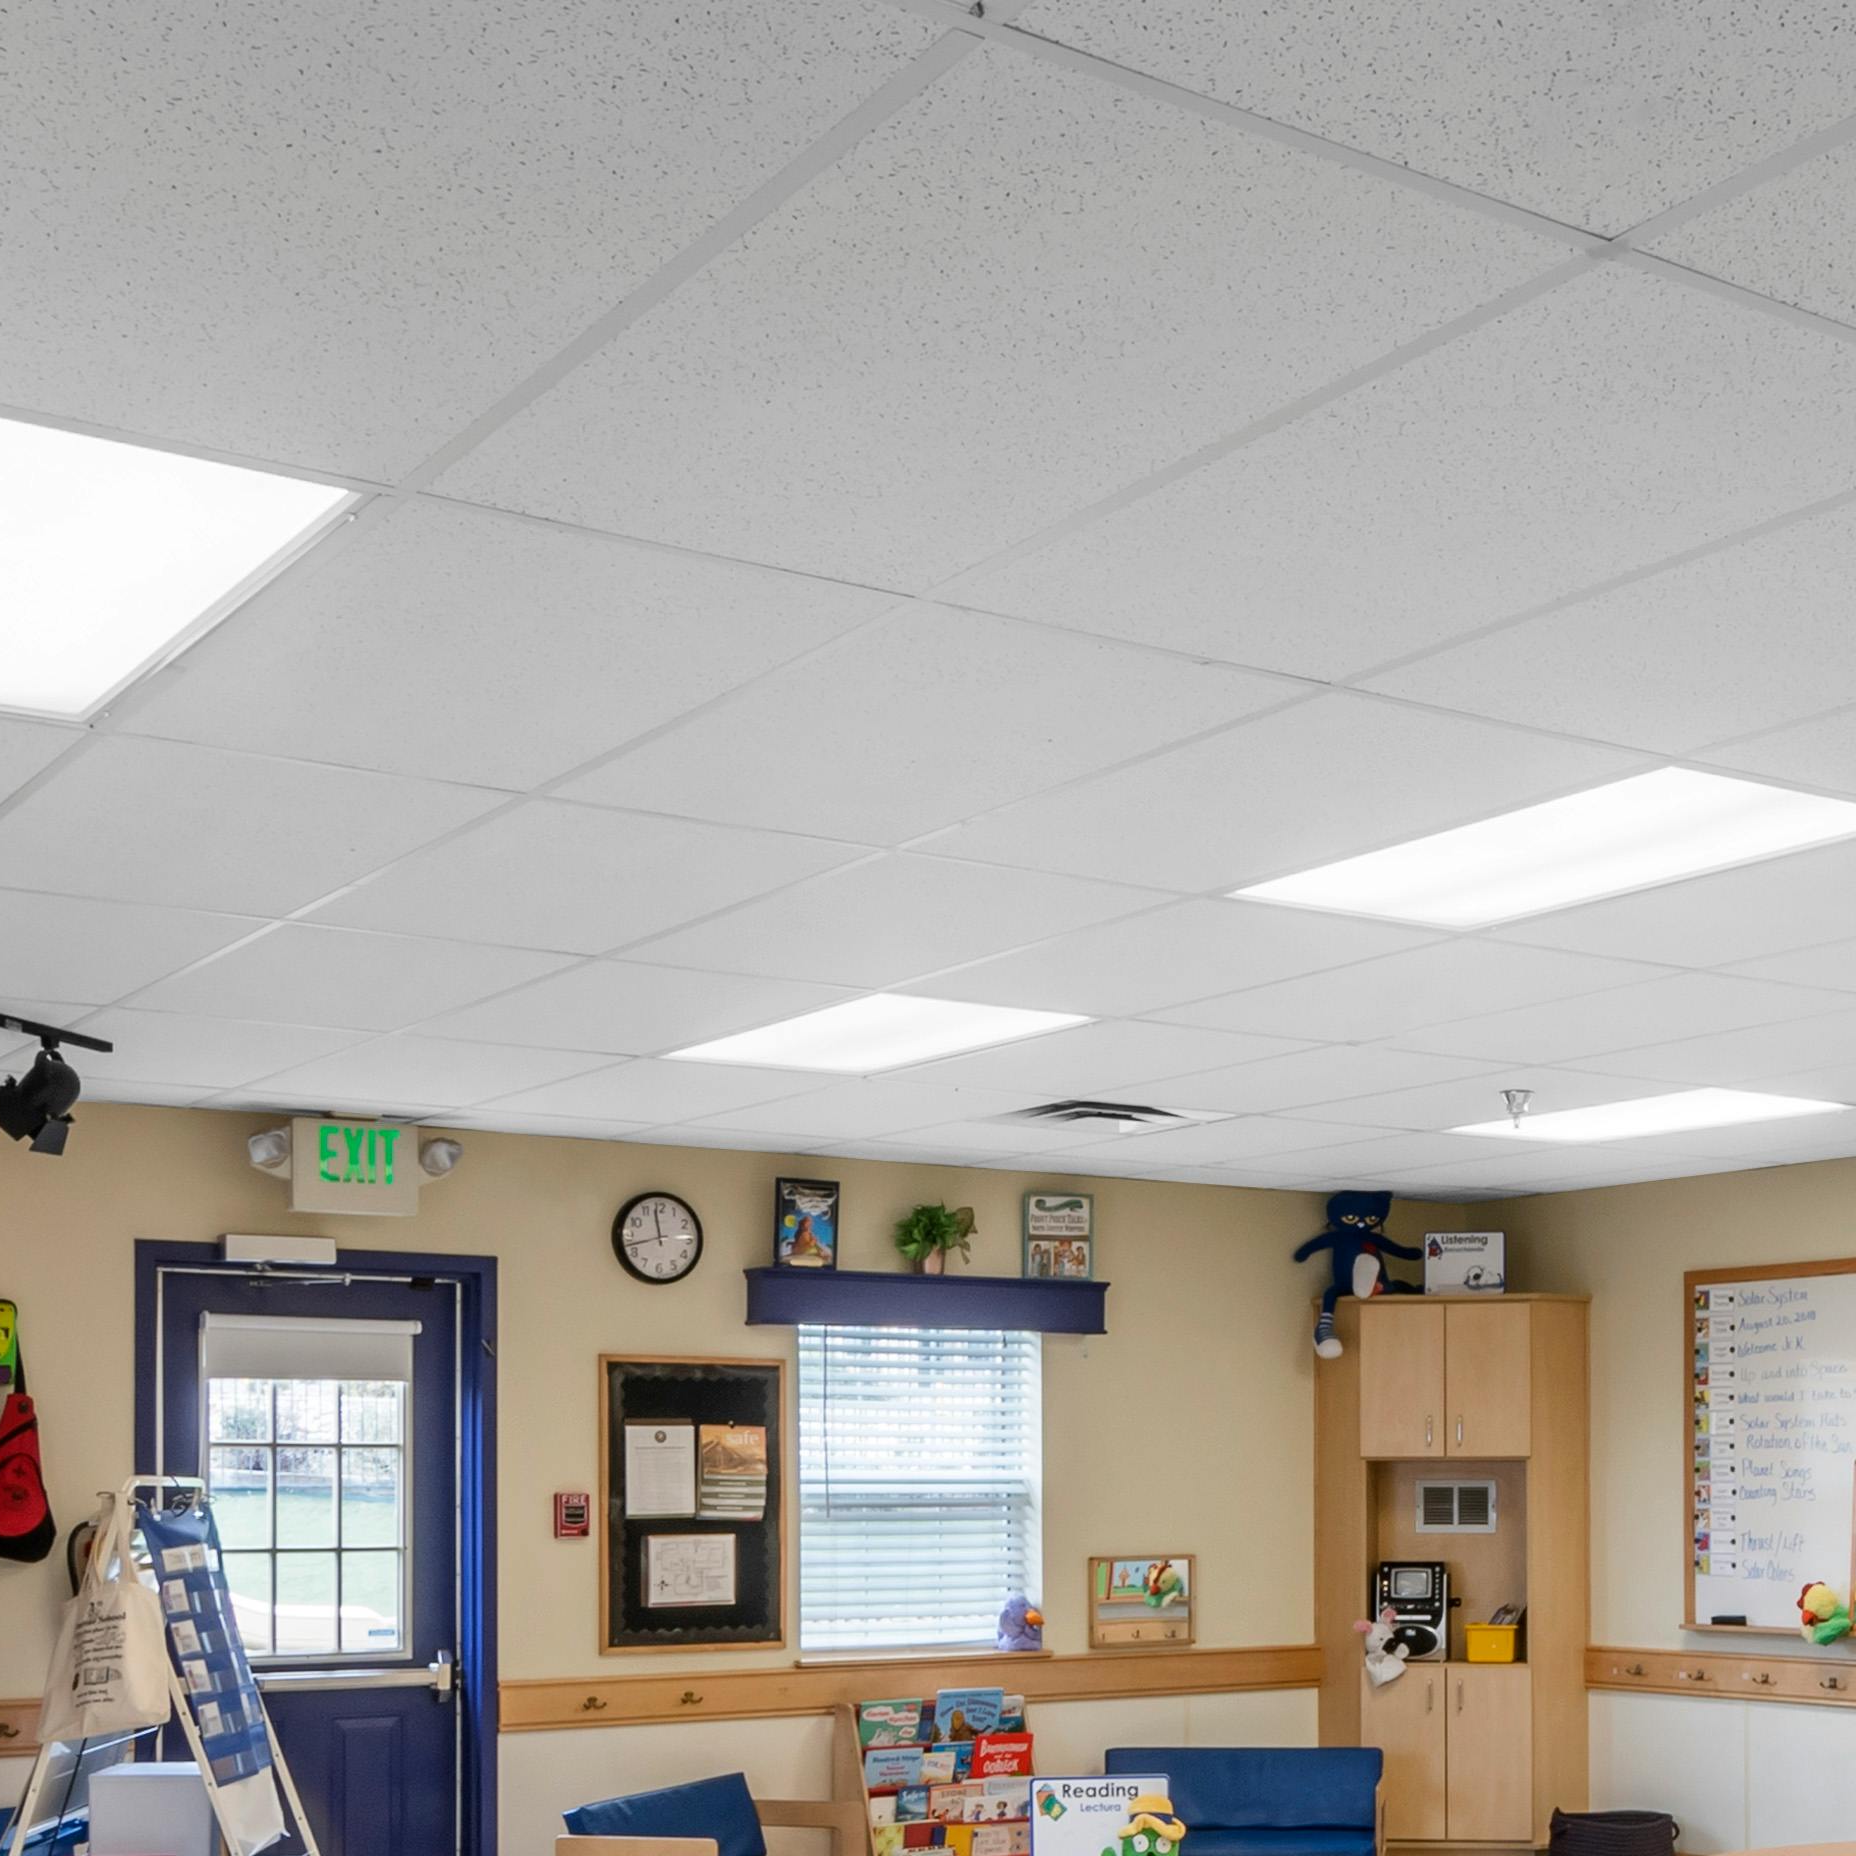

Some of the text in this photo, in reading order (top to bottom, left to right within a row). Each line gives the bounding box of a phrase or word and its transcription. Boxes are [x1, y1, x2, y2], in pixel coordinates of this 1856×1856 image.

[319, 1125, 400, 1184] EXIT
[642, 1206, 650, 1216] 11
[672, 1207, 677, 1217] 1
[630, 1217, 642, 1228] 10
[681, 1219, 688, 1230] 2
[1441, 1235, 1489, 1246] Listening
[630, 1247, 638, 1258] 8
[680, 1249, 688, 1259] 4
[641, 1258, 648, 1268] 7
[655, 1263, 663, 1273] 6
[670, 1260, 677, 1271] 5
[726, 1430, 760, 1445] safe
[562, 1494, 587, 1505] FIRE
[1062, 1783, 1139, 1801] Reading
[1080, 1802, 1122, 1813] Lectura
